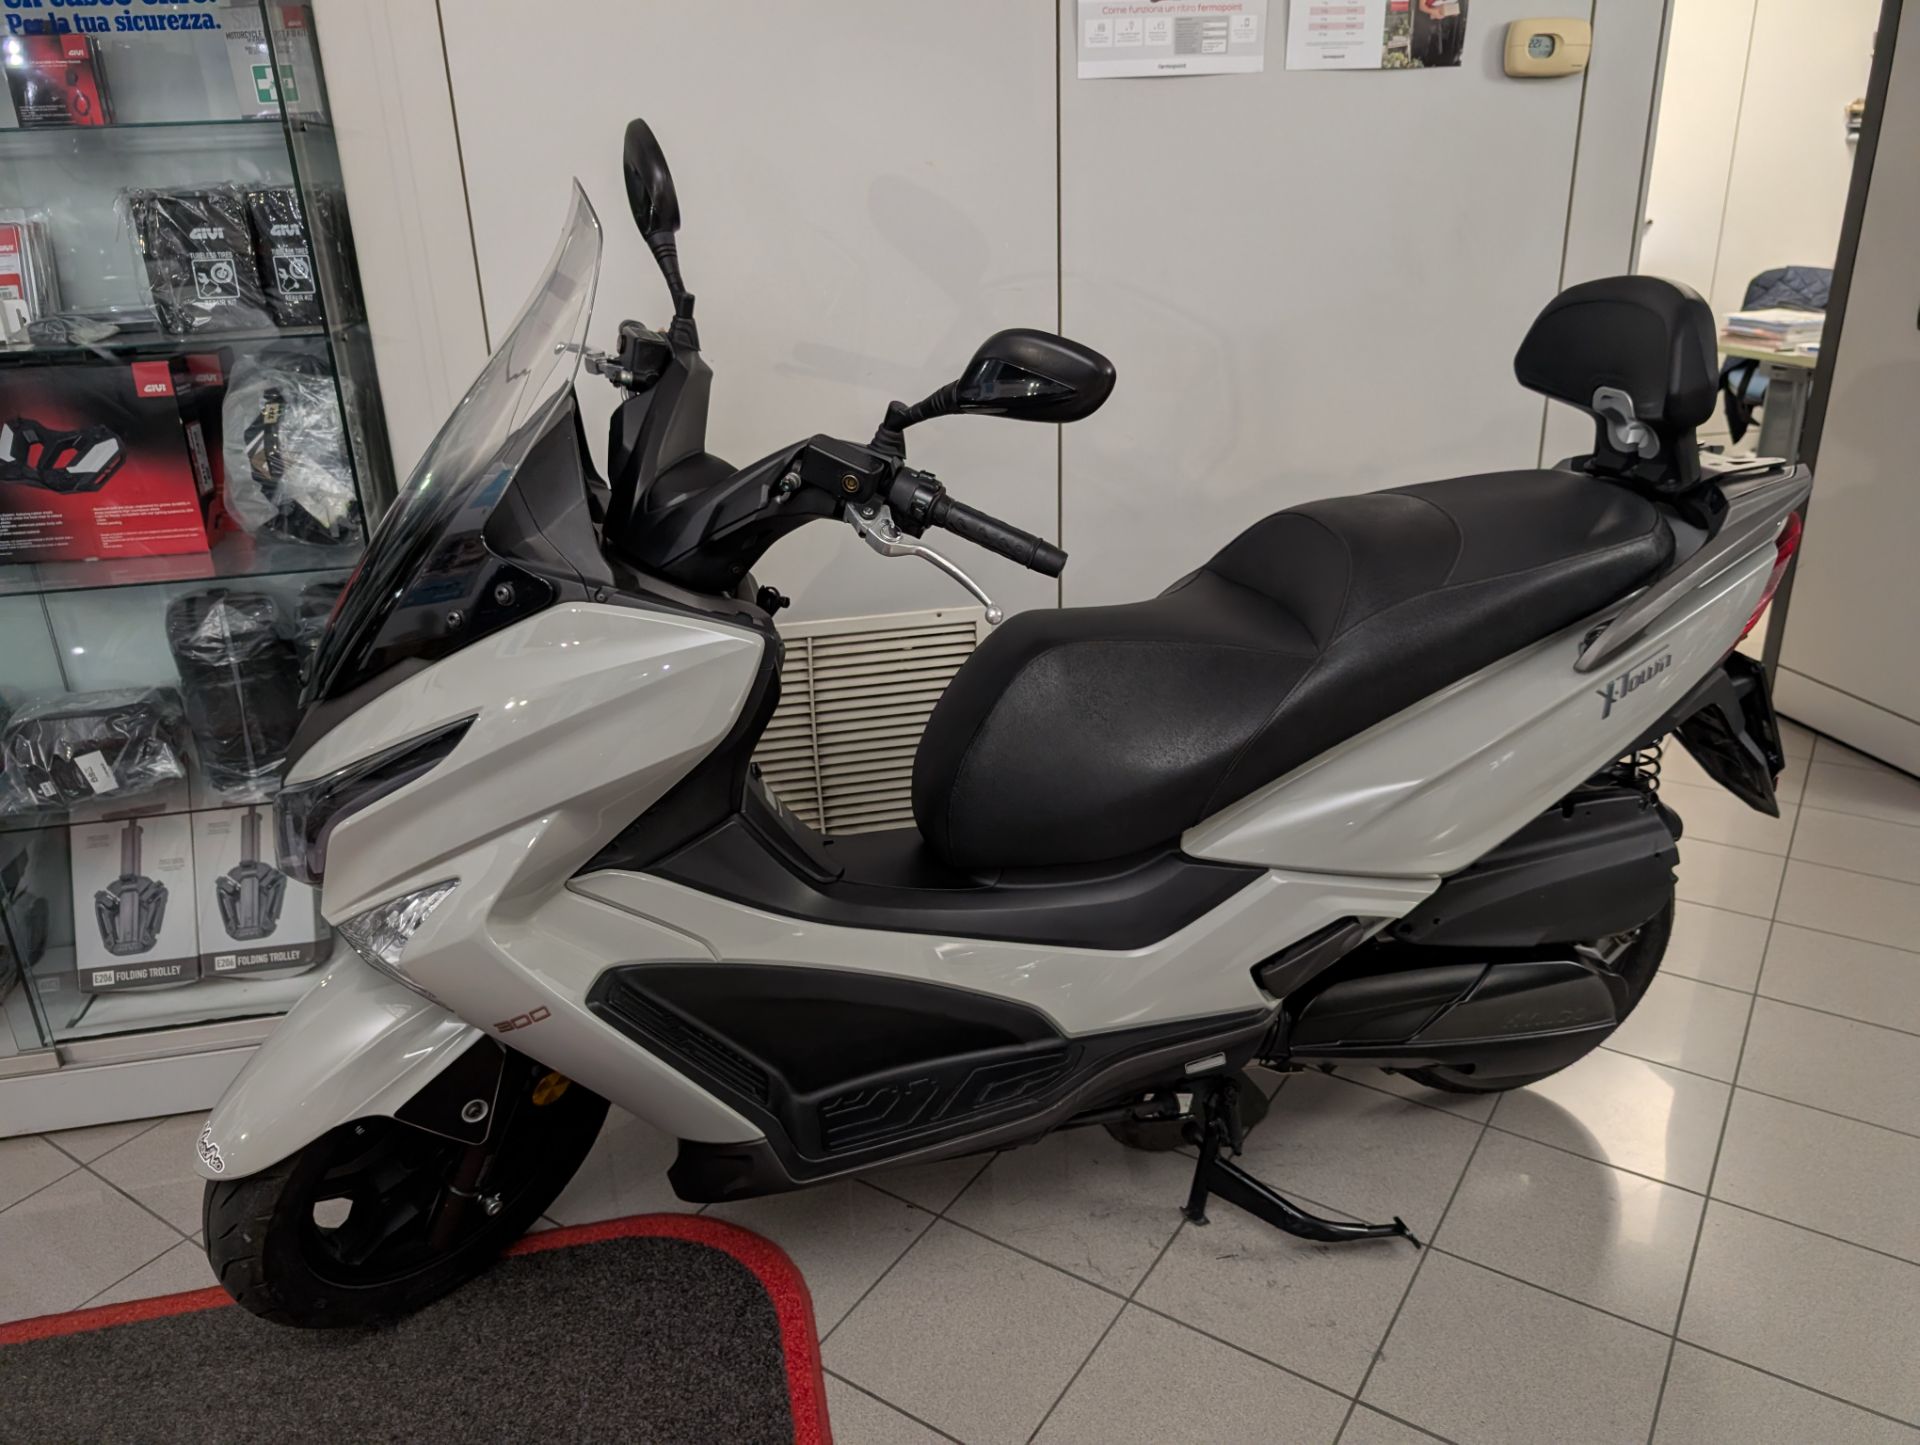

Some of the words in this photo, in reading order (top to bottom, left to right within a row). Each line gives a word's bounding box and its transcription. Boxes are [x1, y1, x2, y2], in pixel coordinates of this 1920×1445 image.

[73, 13, 111, 32] tua
[114, 9, 222, 32] sicurezza.
[189, 227, 224, 240] GIVI
[270, 223, 301, 236] GIVI
[143, 383, 167, 393] GIVI
[216, 956, 235, 969] E206
[237, 953, 269, 967] FOLDING
[269, 949, 301, 963] TROLLEY
[93, 972, 113, 985] E206
[115, 968, 149, 982] FOLDING
[148, 964, 182, 977] TROLLEY
[493, 1005, 552, 1033] 300
